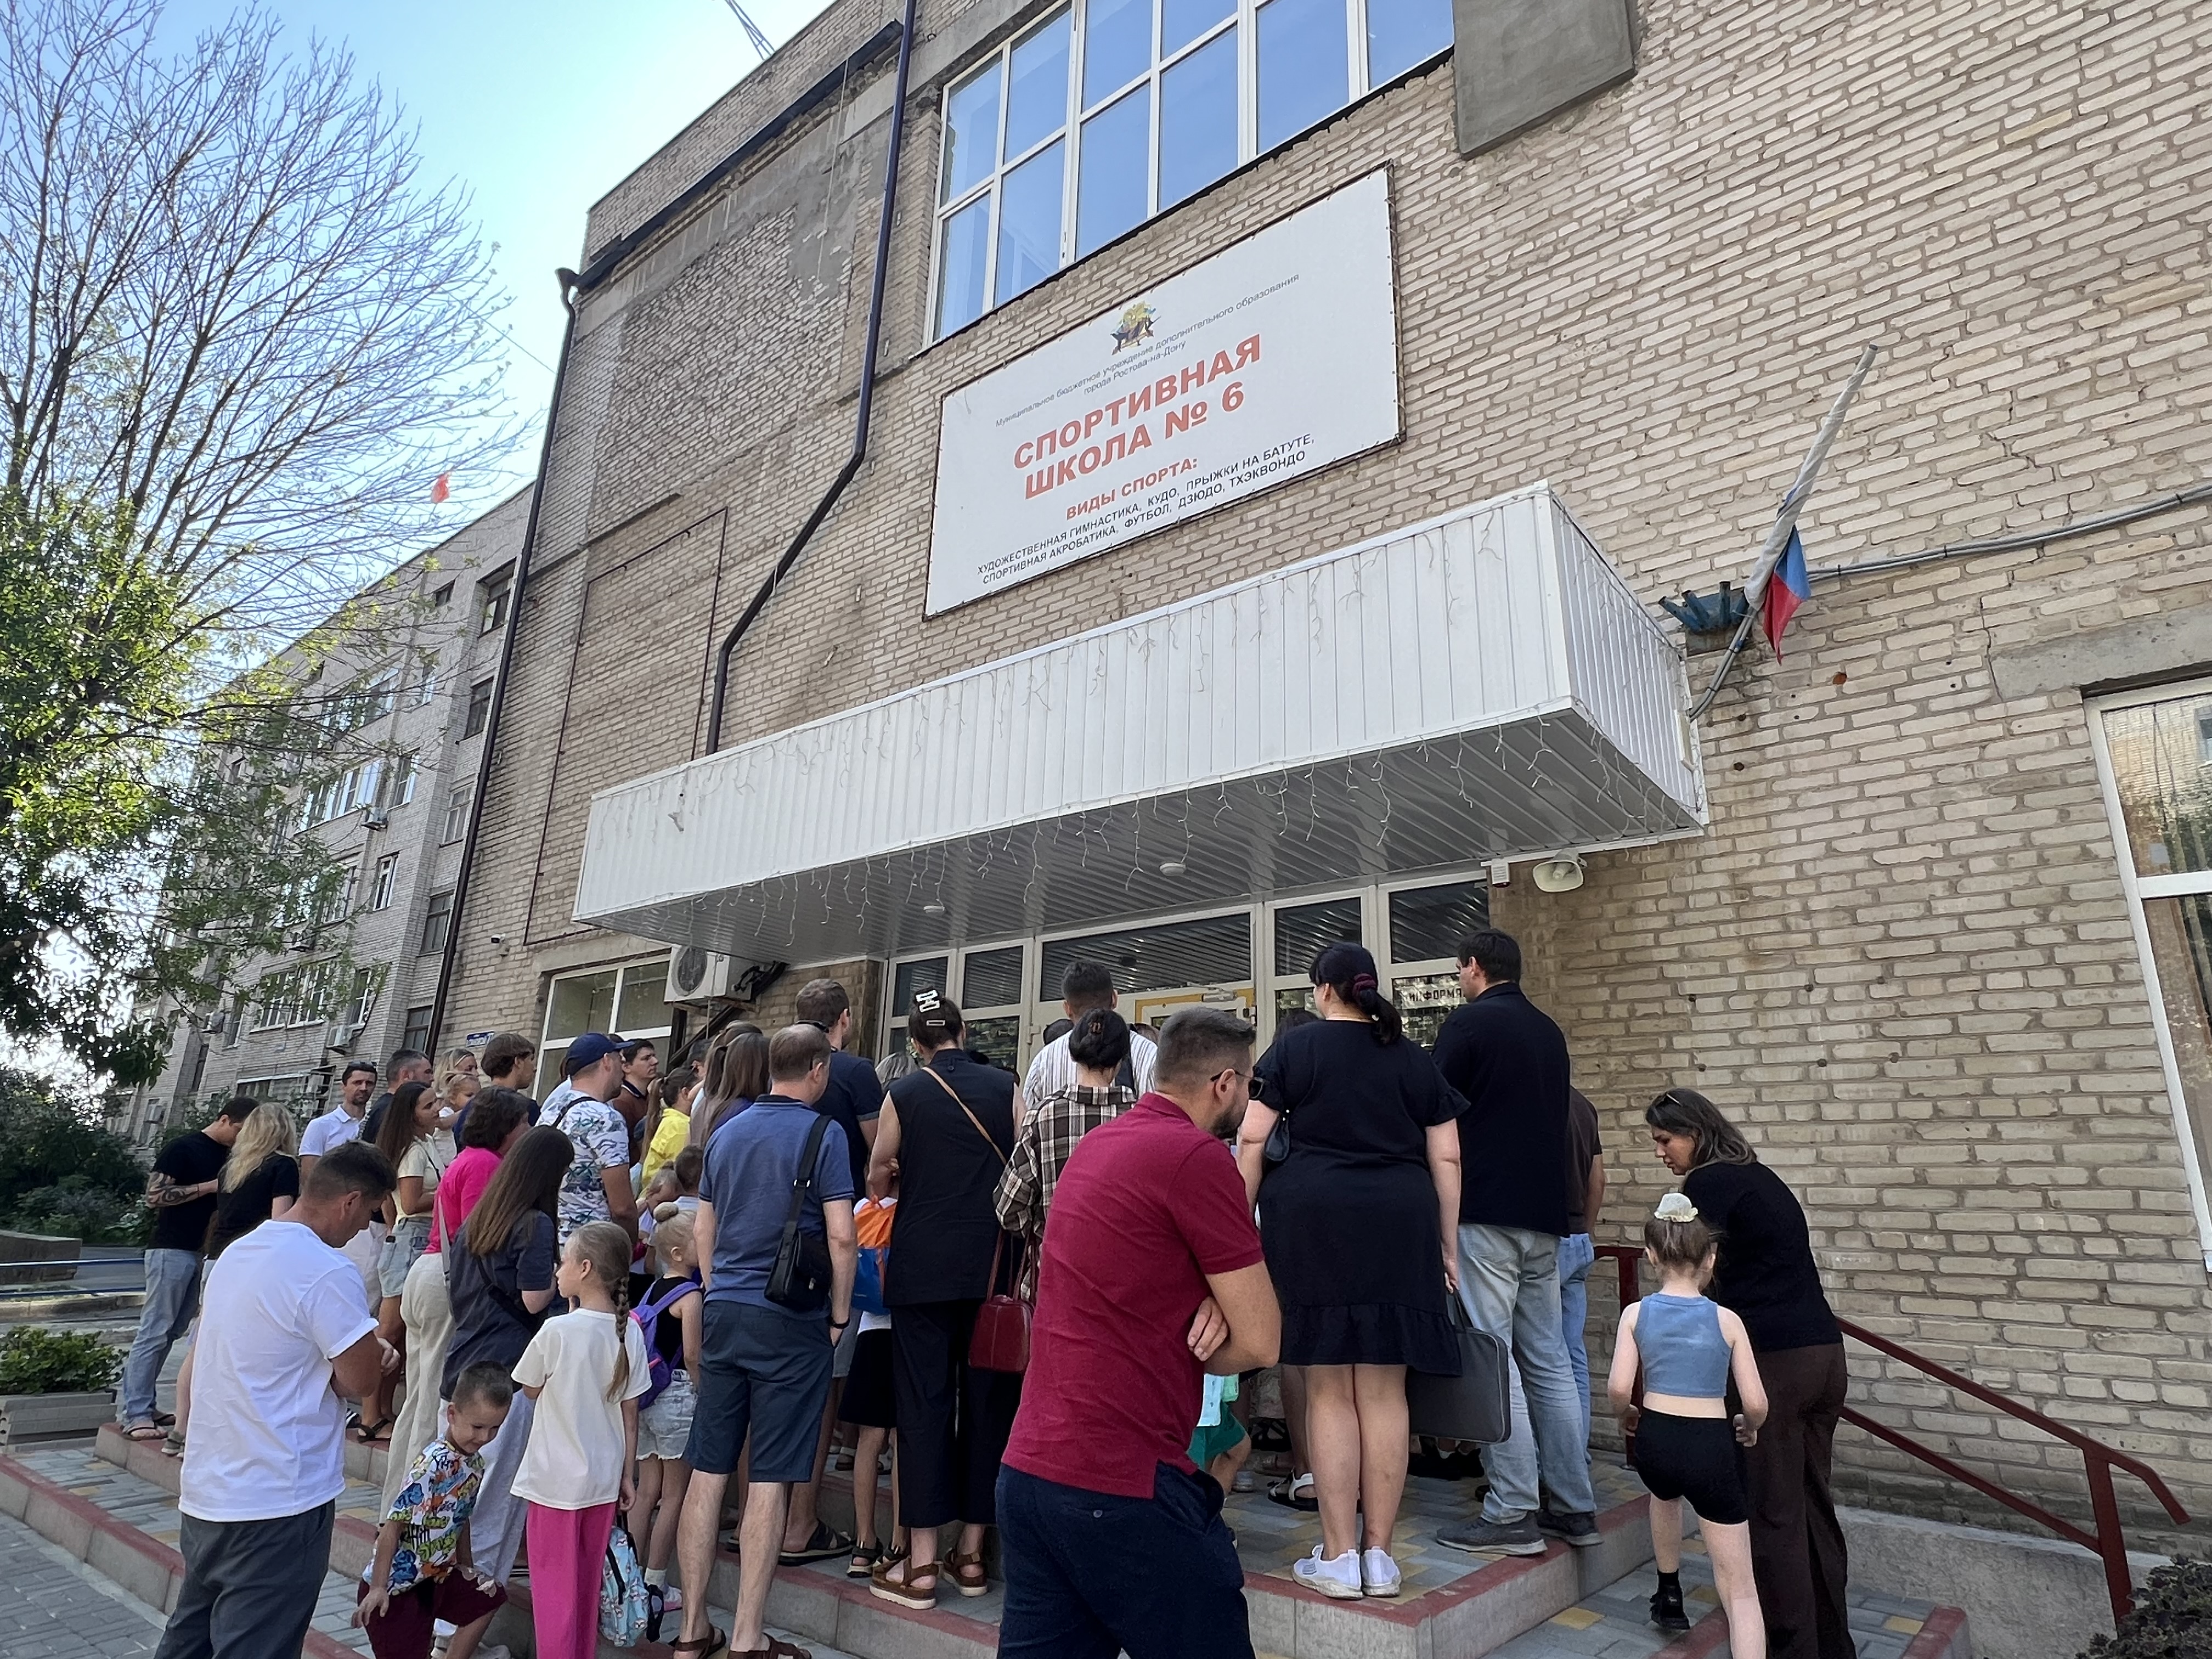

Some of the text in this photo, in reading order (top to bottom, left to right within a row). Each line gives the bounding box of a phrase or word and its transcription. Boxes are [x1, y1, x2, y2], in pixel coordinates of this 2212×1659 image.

[995, 274, 1300, 427] Муниципальное бюджетное учреждение дополнительного образования
[1014, 334, 1260, 469] СПОРТИВНАЯ
[1084, 340, 1186, 395] города Ростова-на-Дону
[978, 433, 1314, 574] ХУДОЖЕСТВЕННАЯ ГИМНАСТИКА, КУДО, ПРЫЖКИ НА БАТУТЕ,
[1025, 381, 1244, 499] ШКОЛА № 6
[1066, 458, 1197, 520] ВИДЫ СПОРТА:
[983, 450, 1305, 584] СПОРТИВНАЯ АКРОБАТИКА, ФУТБОЛ, ДЗЮДО, ТХЭКВОНДО
